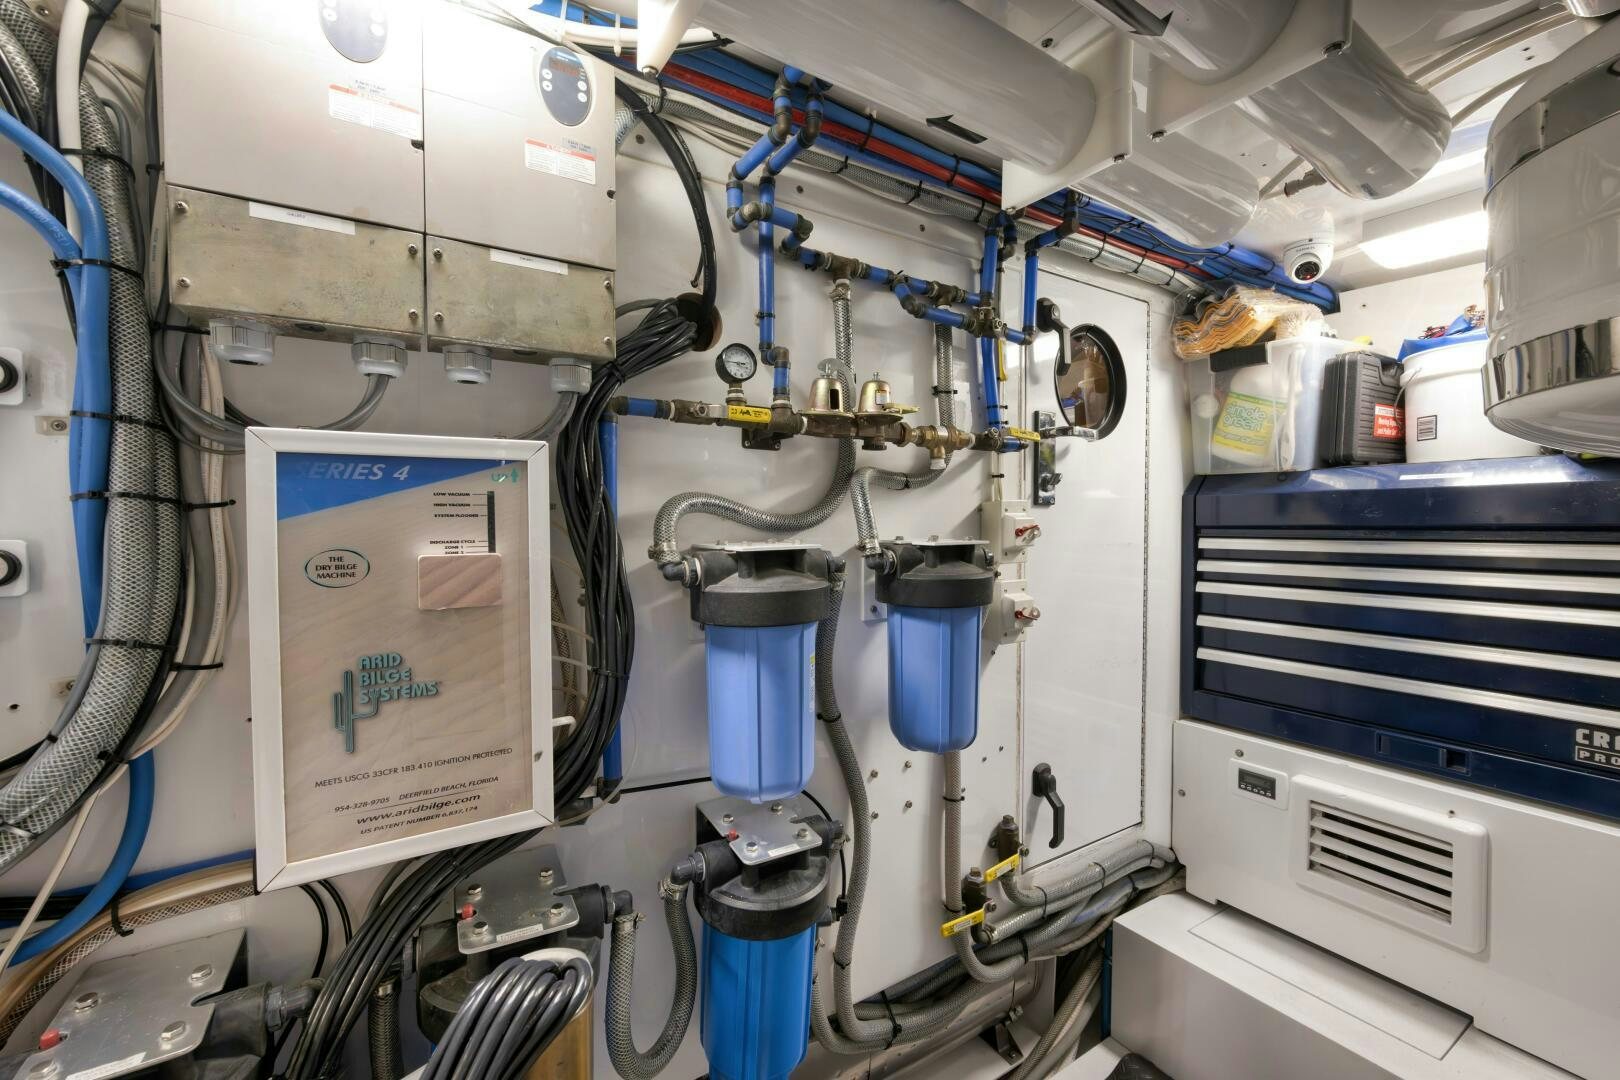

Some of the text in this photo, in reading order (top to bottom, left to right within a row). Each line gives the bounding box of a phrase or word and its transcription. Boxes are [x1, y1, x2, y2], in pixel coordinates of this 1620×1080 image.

[392, 465, 410, 481] 4
[315, 564, 332, 572] DRY
[316, 572, 357, 580] MACHINE
[358, 652, 402, 670] ARID
[359, 667, 412, 687] BILGE
[359, 681, 439, 705] SYSTEMS
[314, 778, 343, 788] MEETS
[344, 772, 370, 782] USCG
[372, 767, 399, 778] 33CFR
[434, 755, 471, 766] IGNITION
[472, 747, 513, 760] PROTECTED
[334, 776, 499, 813] 954-328-9705 DEERFIELD BEACH, FLORIDA
[356, 794, 481, 825] www.aridbilge.com
[373, 821, 404, 832] PATENT
[406, 813, 440, 825] NUMBER
